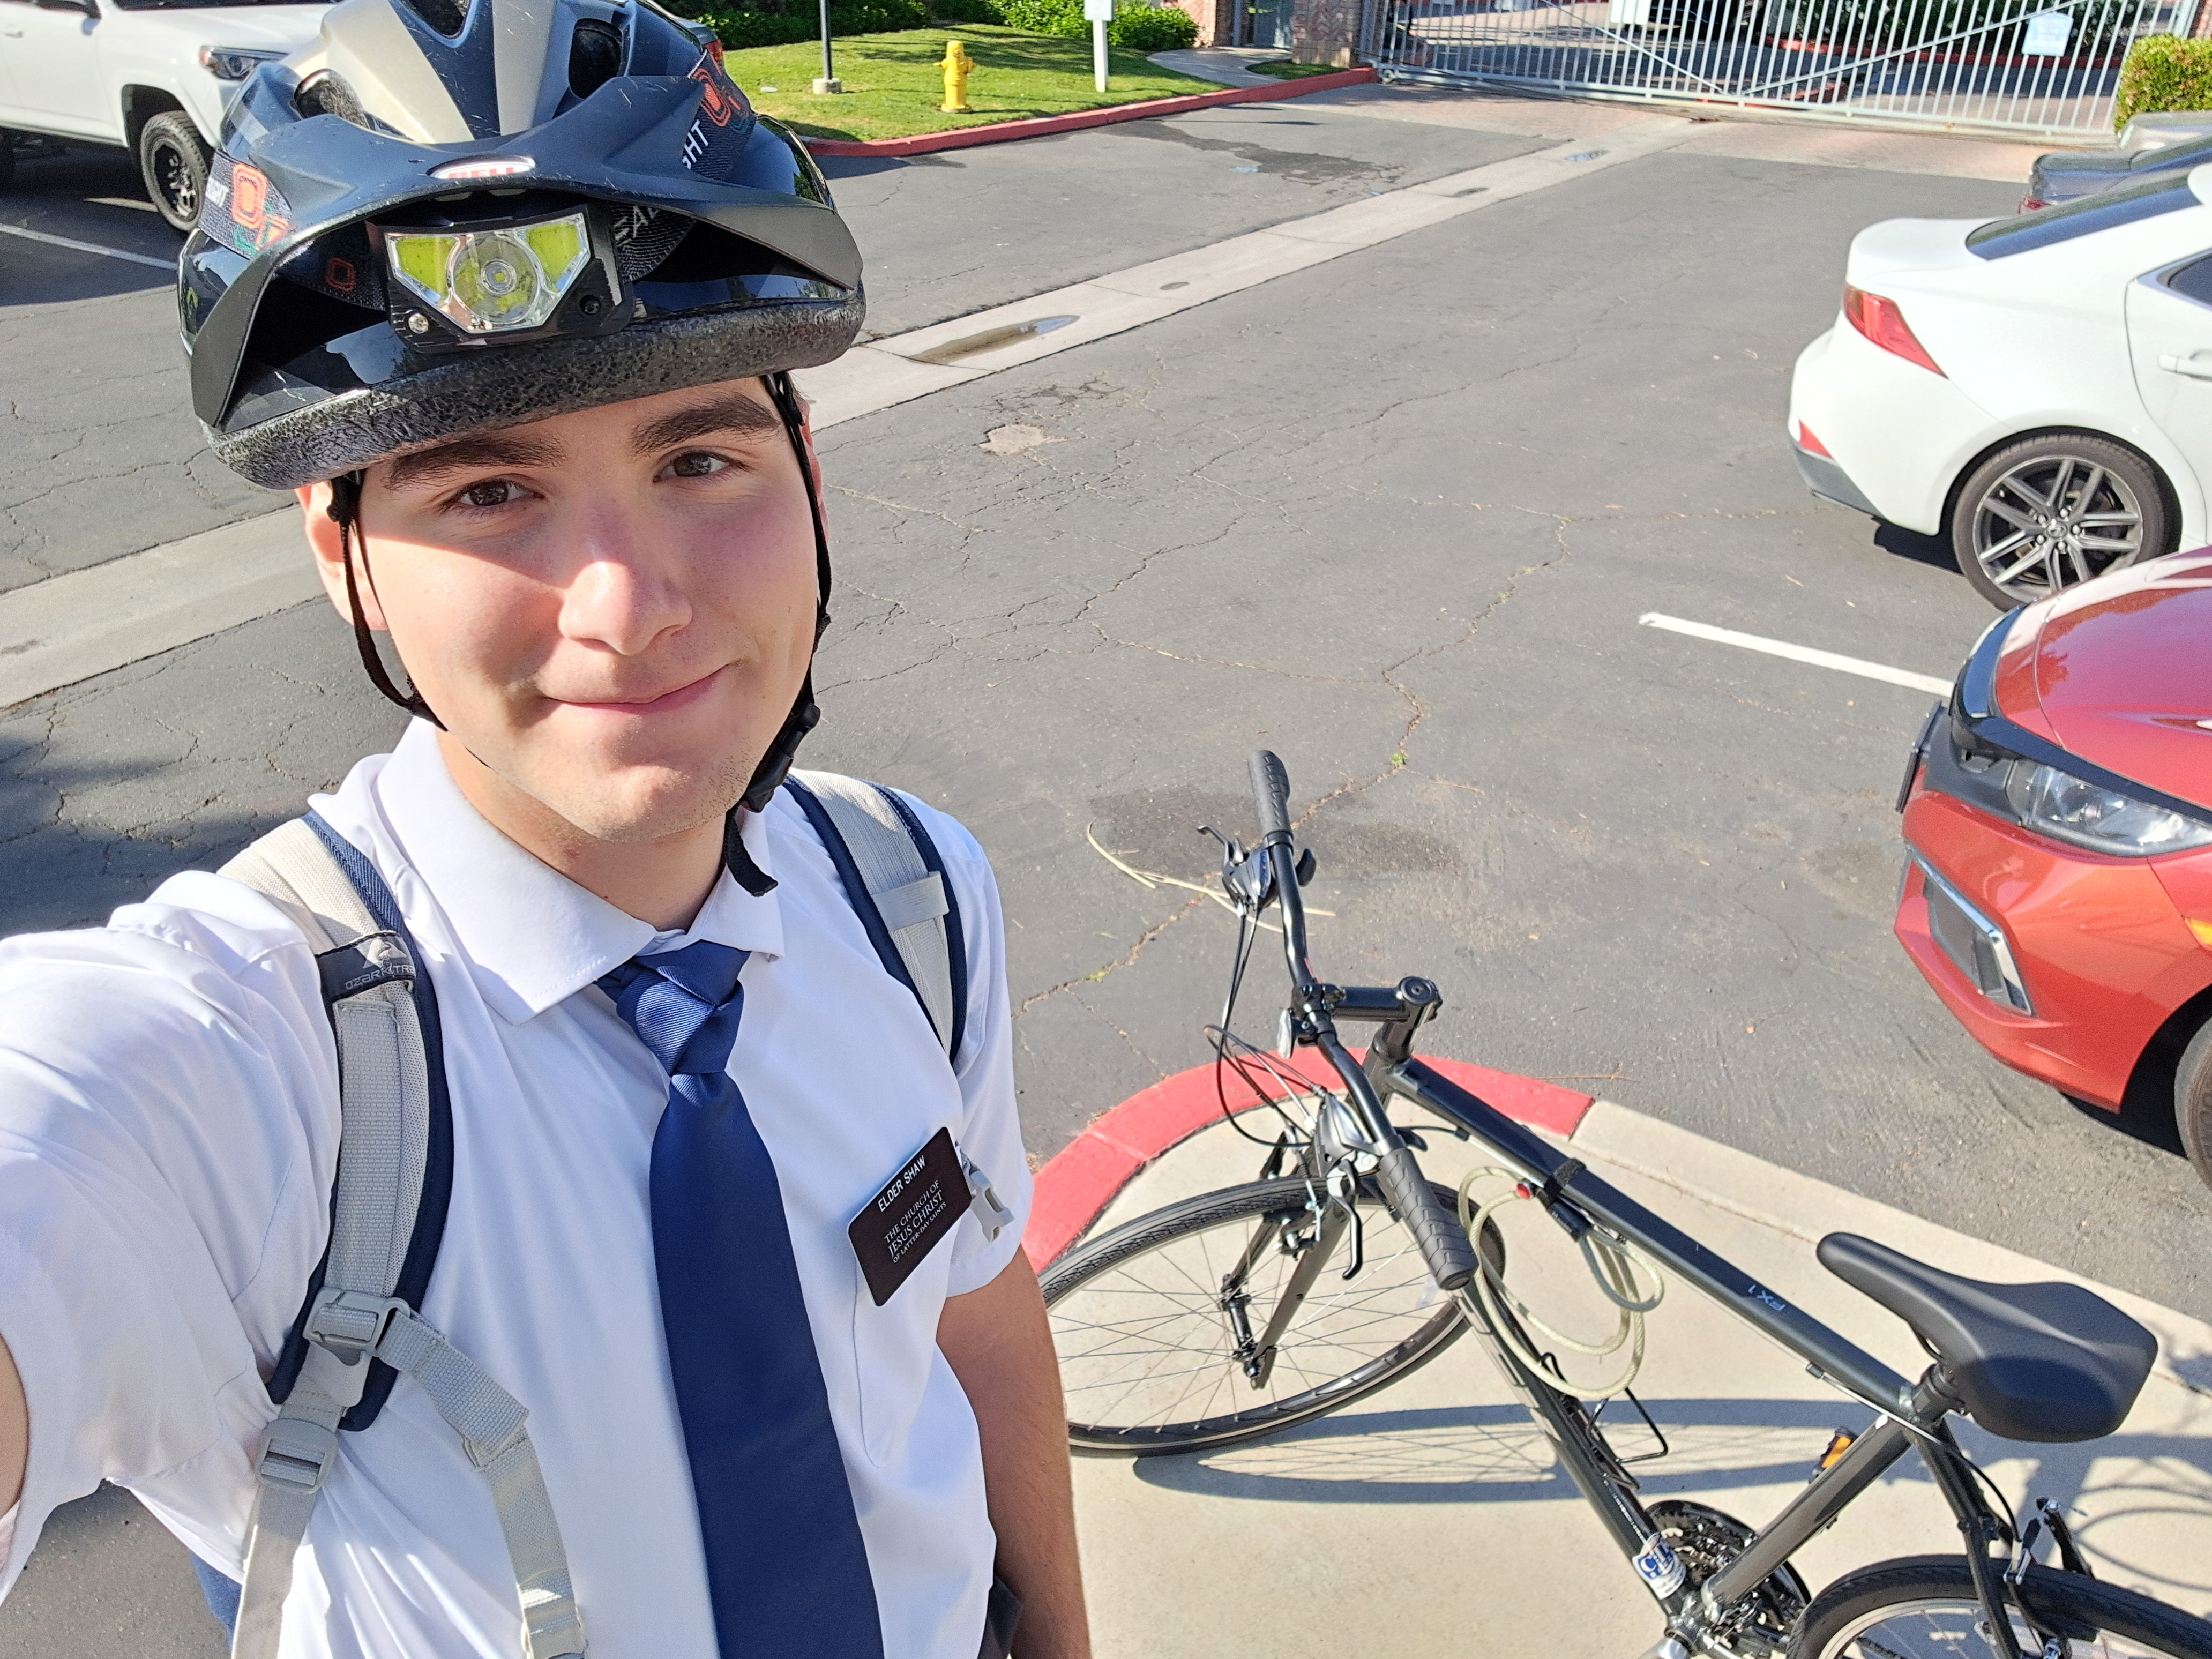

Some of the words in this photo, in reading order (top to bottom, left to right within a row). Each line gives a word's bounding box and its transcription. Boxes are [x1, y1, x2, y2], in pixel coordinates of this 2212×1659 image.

[878, 1179, 904, 1213] ELDER
[903, 1154, 926, 1185] SHAW
[884, 1224, 900, 1244] THE
[900, 1191, 930, 1227] CHURCH
[930, 1179, 940, 1194] OF
[888, 1224, 913, 1259] JESUS
[913, 1189, 943, 1228] CHRIST
[893, 1252, 901, 1264] OF
[900, 1219, 930, 1255] LATTER-DAY
[929, 1201, 947, 1223] SAINTS
